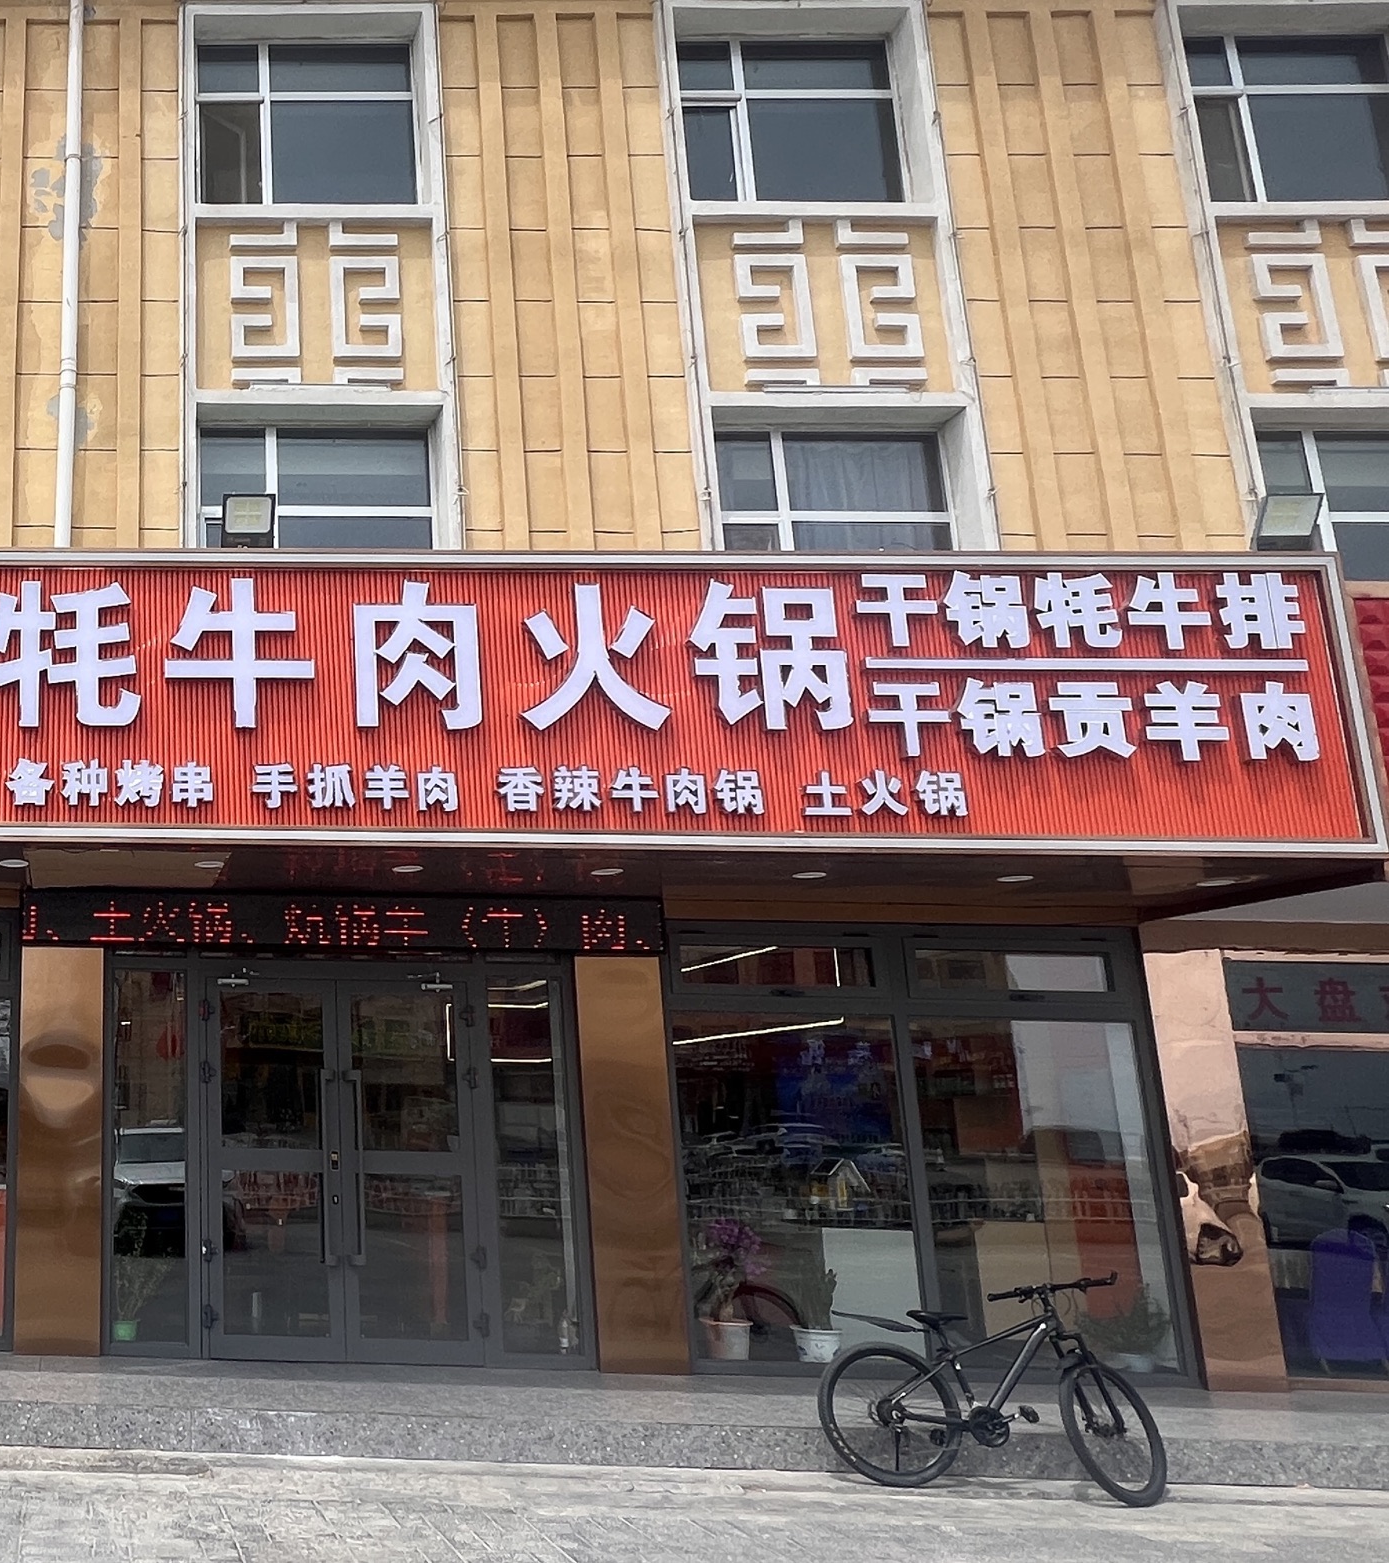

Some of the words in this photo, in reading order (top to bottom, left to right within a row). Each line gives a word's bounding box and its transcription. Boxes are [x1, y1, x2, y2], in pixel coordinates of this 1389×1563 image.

[854, 569, 1308, 652] 干锅牦牛排
[866, 677, 1322, 763] 干锅贡羊肉
[5, 755, 215, 808] 各种烤串
[251, 762, 459, 813] 手抓羊肉
[497, 765, 766, 816] 香辣牛肉锅
[804, 768, 970, 817] 土火锅
